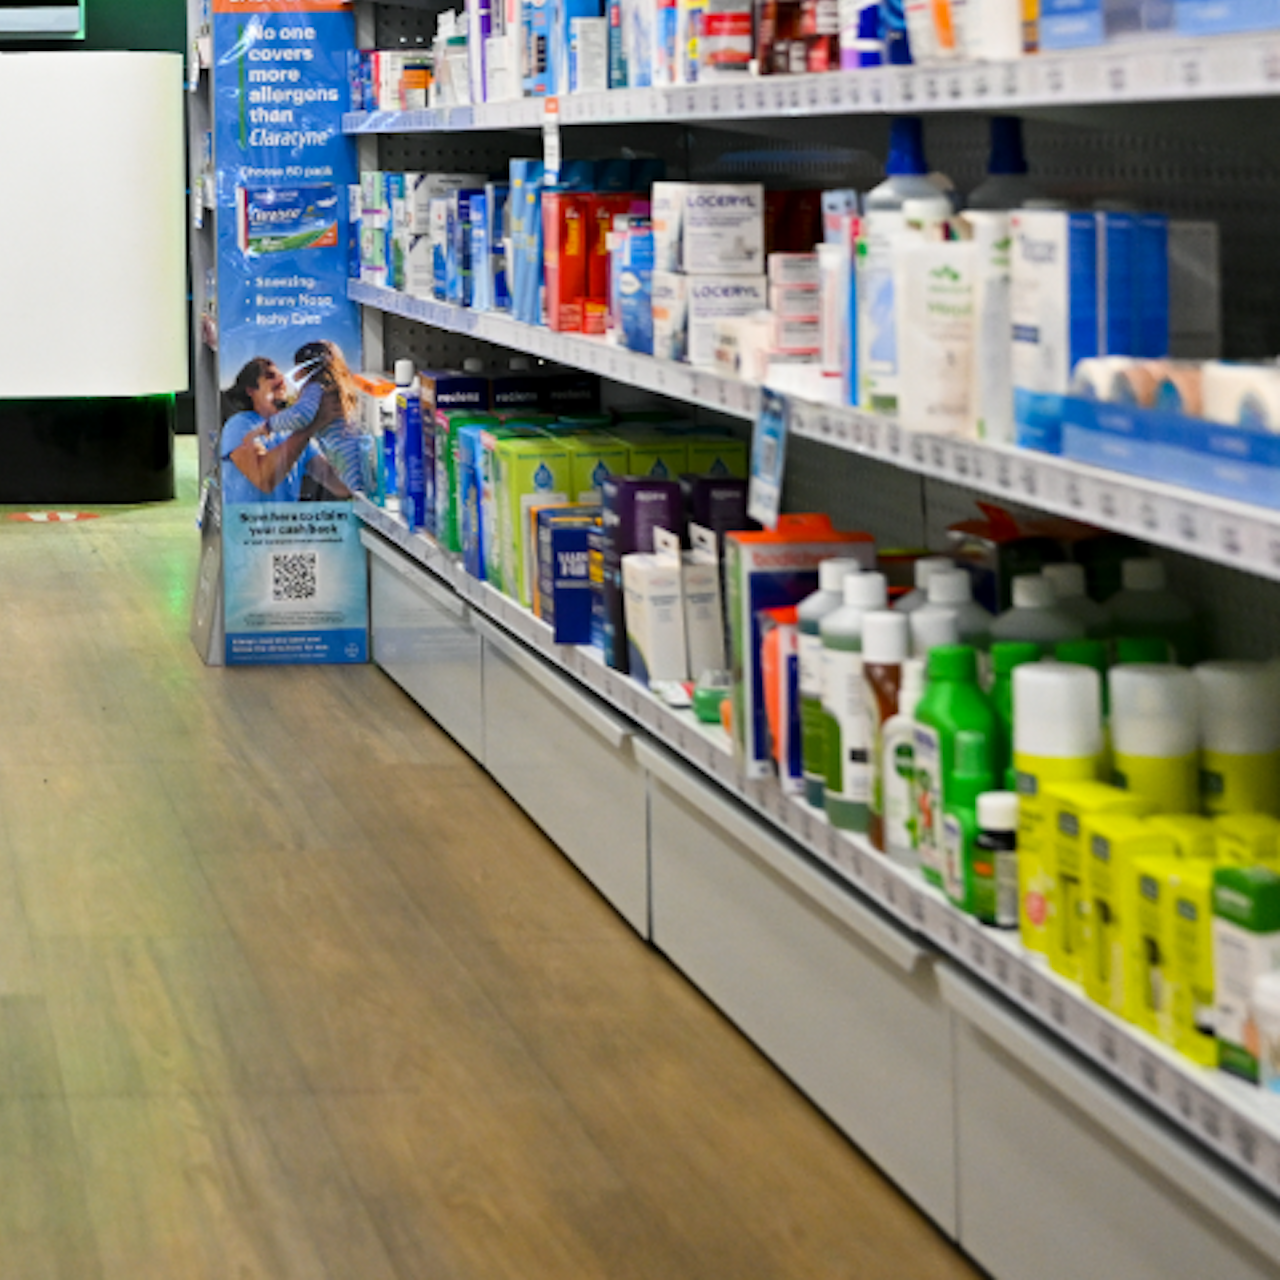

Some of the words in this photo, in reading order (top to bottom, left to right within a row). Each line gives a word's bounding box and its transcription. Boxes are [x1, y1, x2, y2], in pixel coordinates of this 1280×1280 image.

[279, 26, 316, 40] one
[248, 47, 314, 61] covers
[248, 68, 301, 82] more
[248, 86, 339, 105] allergens
[249, 107, 293, 122] than
[686, 195, 756, 208] LOCERYL
[693, 286, 760, 299] LOCERYL
